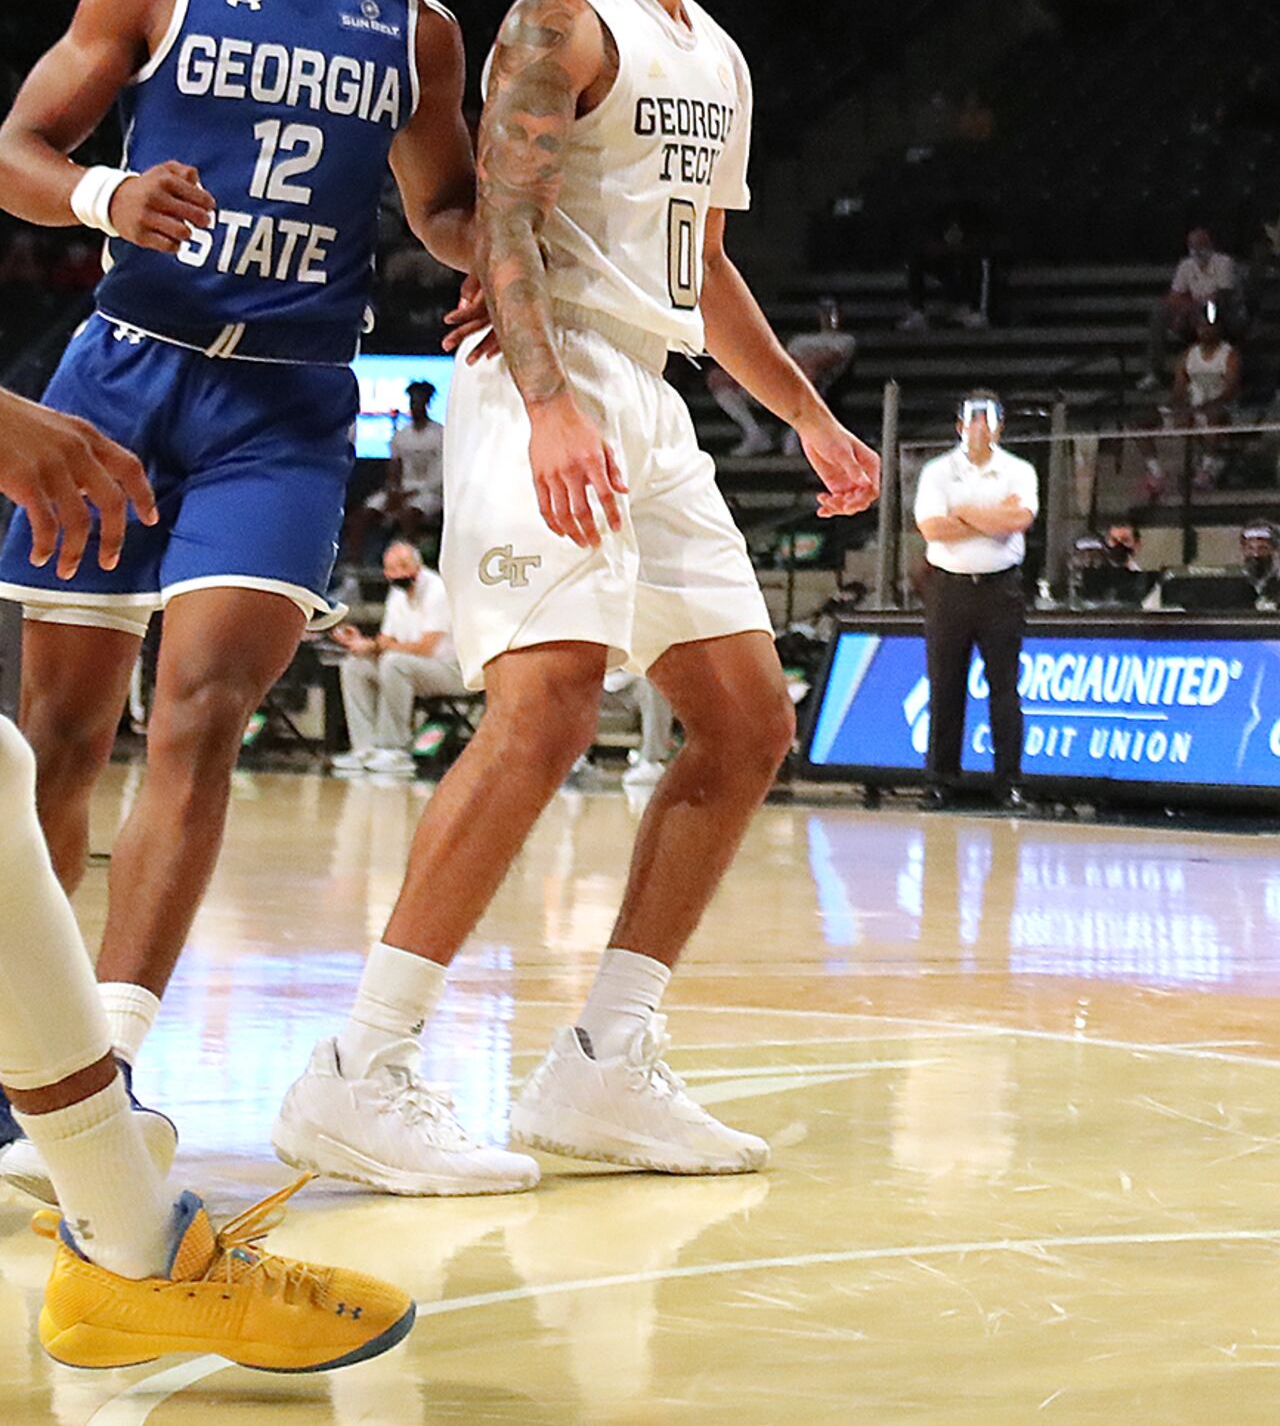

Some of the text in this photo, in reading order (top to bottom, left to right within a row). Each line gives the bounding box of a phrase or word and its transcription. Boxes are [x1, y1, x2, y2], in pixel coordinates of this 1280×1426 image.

[177, 34, 401, 131] GEORGIA
[248, 119, 324, 205] 12
[667, 198, 699, 311] 0
[478, 544, 542, 588] GT
[972, 723, 1193, 764] CDIT UNION
